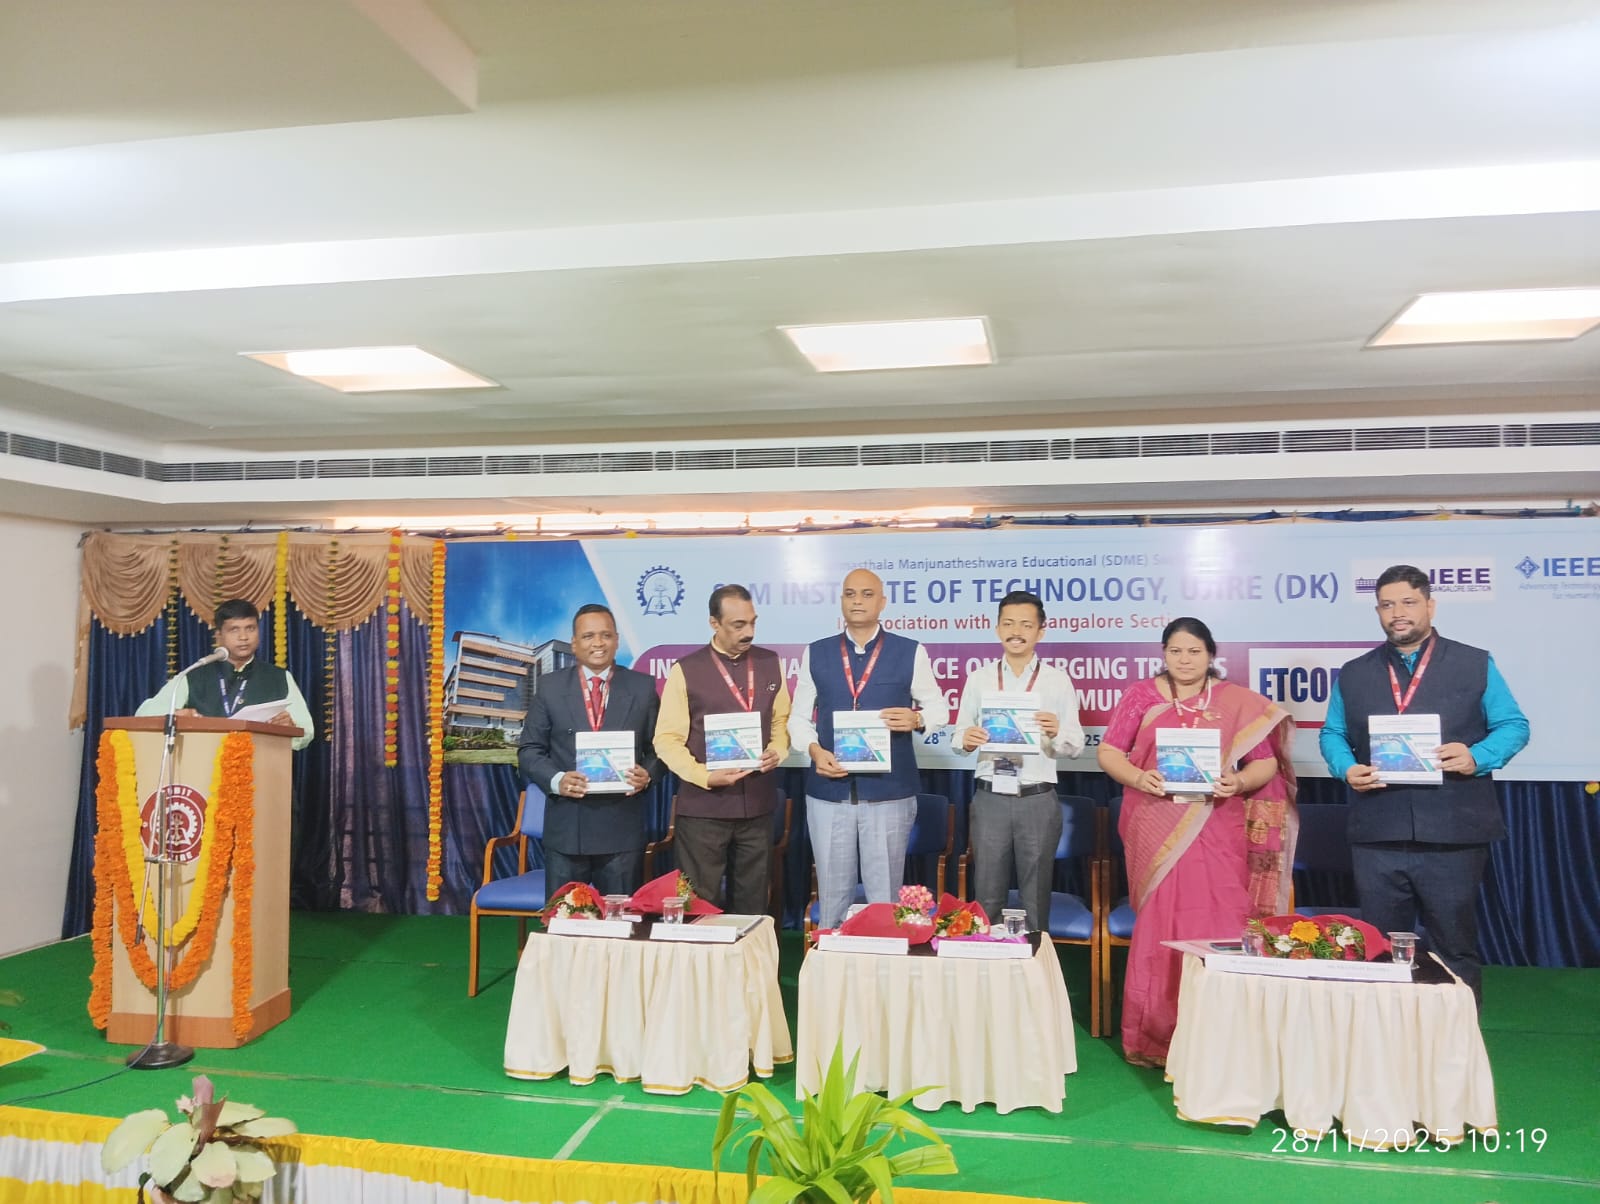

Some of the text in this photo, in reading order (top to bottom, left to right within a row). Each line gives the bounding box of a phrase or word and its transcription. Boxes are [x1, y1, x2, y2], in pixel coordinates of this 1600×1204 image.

[899, 557, 1017, 572] Manjunatheshwara
[1022, 555, 1096, 568] Educational
[1101, 555, 1148, 568] (SDME)
[1544, 557, 1600, 576] IEEE
[1430, 568, 1490, 584] IEEE
[927, 580, 962, 604] OF
[1274, 572, 1338, 604] (DK)
[955, 614, 991, 630] with
